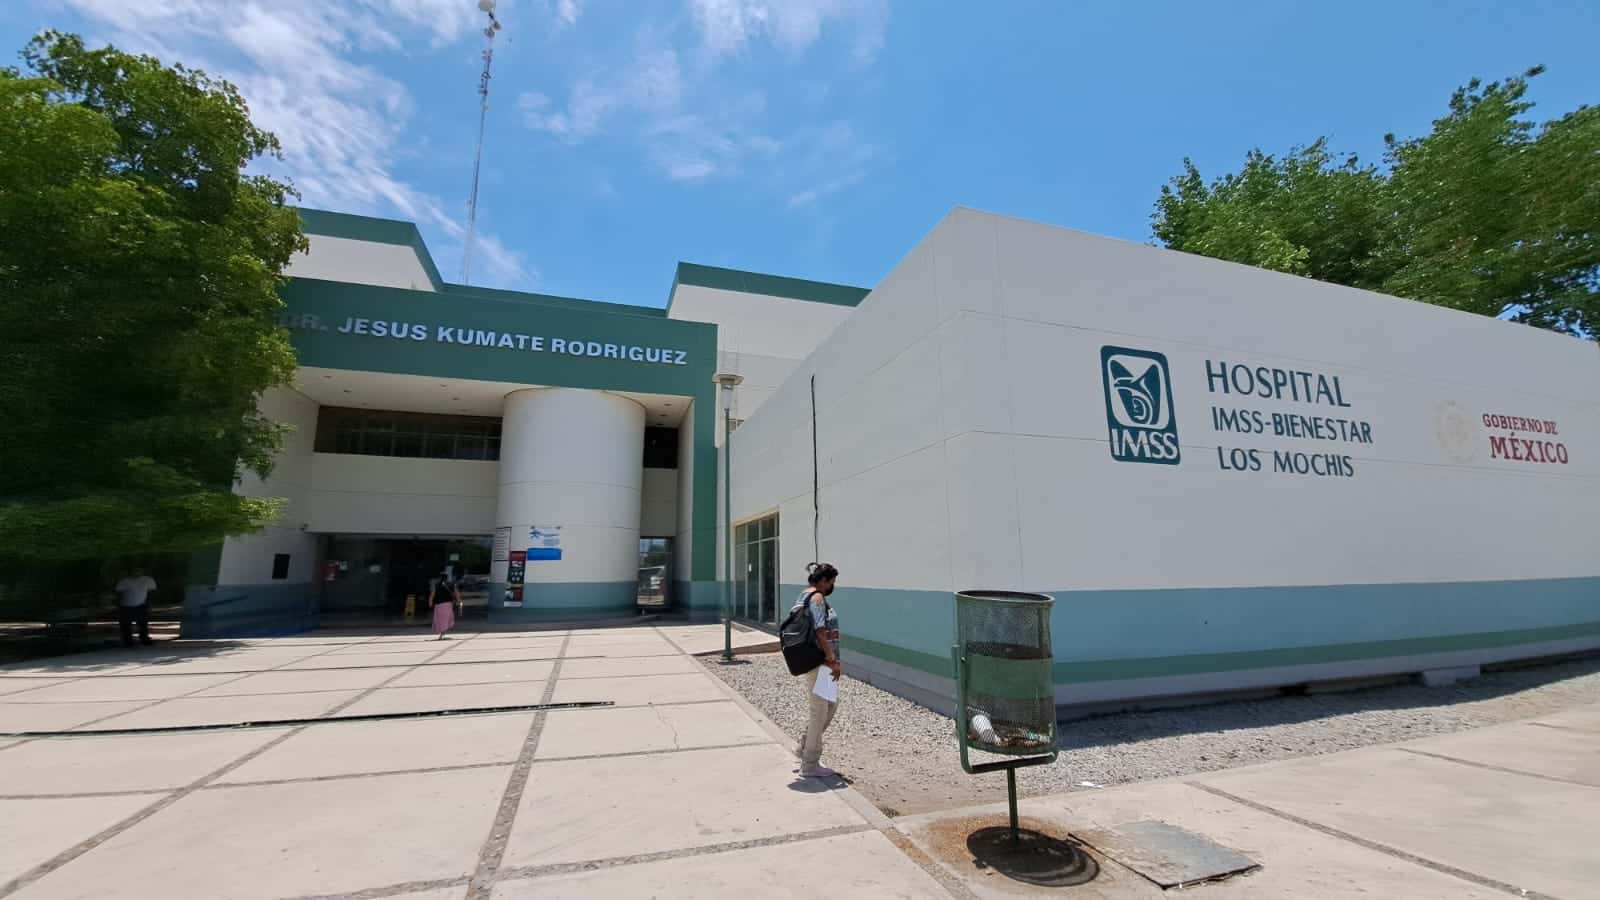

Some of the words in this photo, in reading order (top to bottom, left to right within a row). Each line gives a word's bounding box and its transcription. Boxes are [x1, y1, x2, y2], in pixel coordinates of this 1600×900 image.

[338, 317, 428, 341] JESUS
[436, 326, 544, 352] KUMATE
[551, 337, 688, 366] RODRIGUEZ
[1205, 359, 1351, 408] HOSPITAL
[1212, 406, 1373, 444] IMSS-BIENESTAR
[1482, 413, 1543, 432] GOBIERNO
[1544, 420, 1558, 435] DE
[1111, 427, 1178, 460] IMSS
[1489, 431, 1568, 464] MÉXICO
[1217, 446, 1262, 471] LOS
[1273, 450, 1354, 477] MOCHIS
